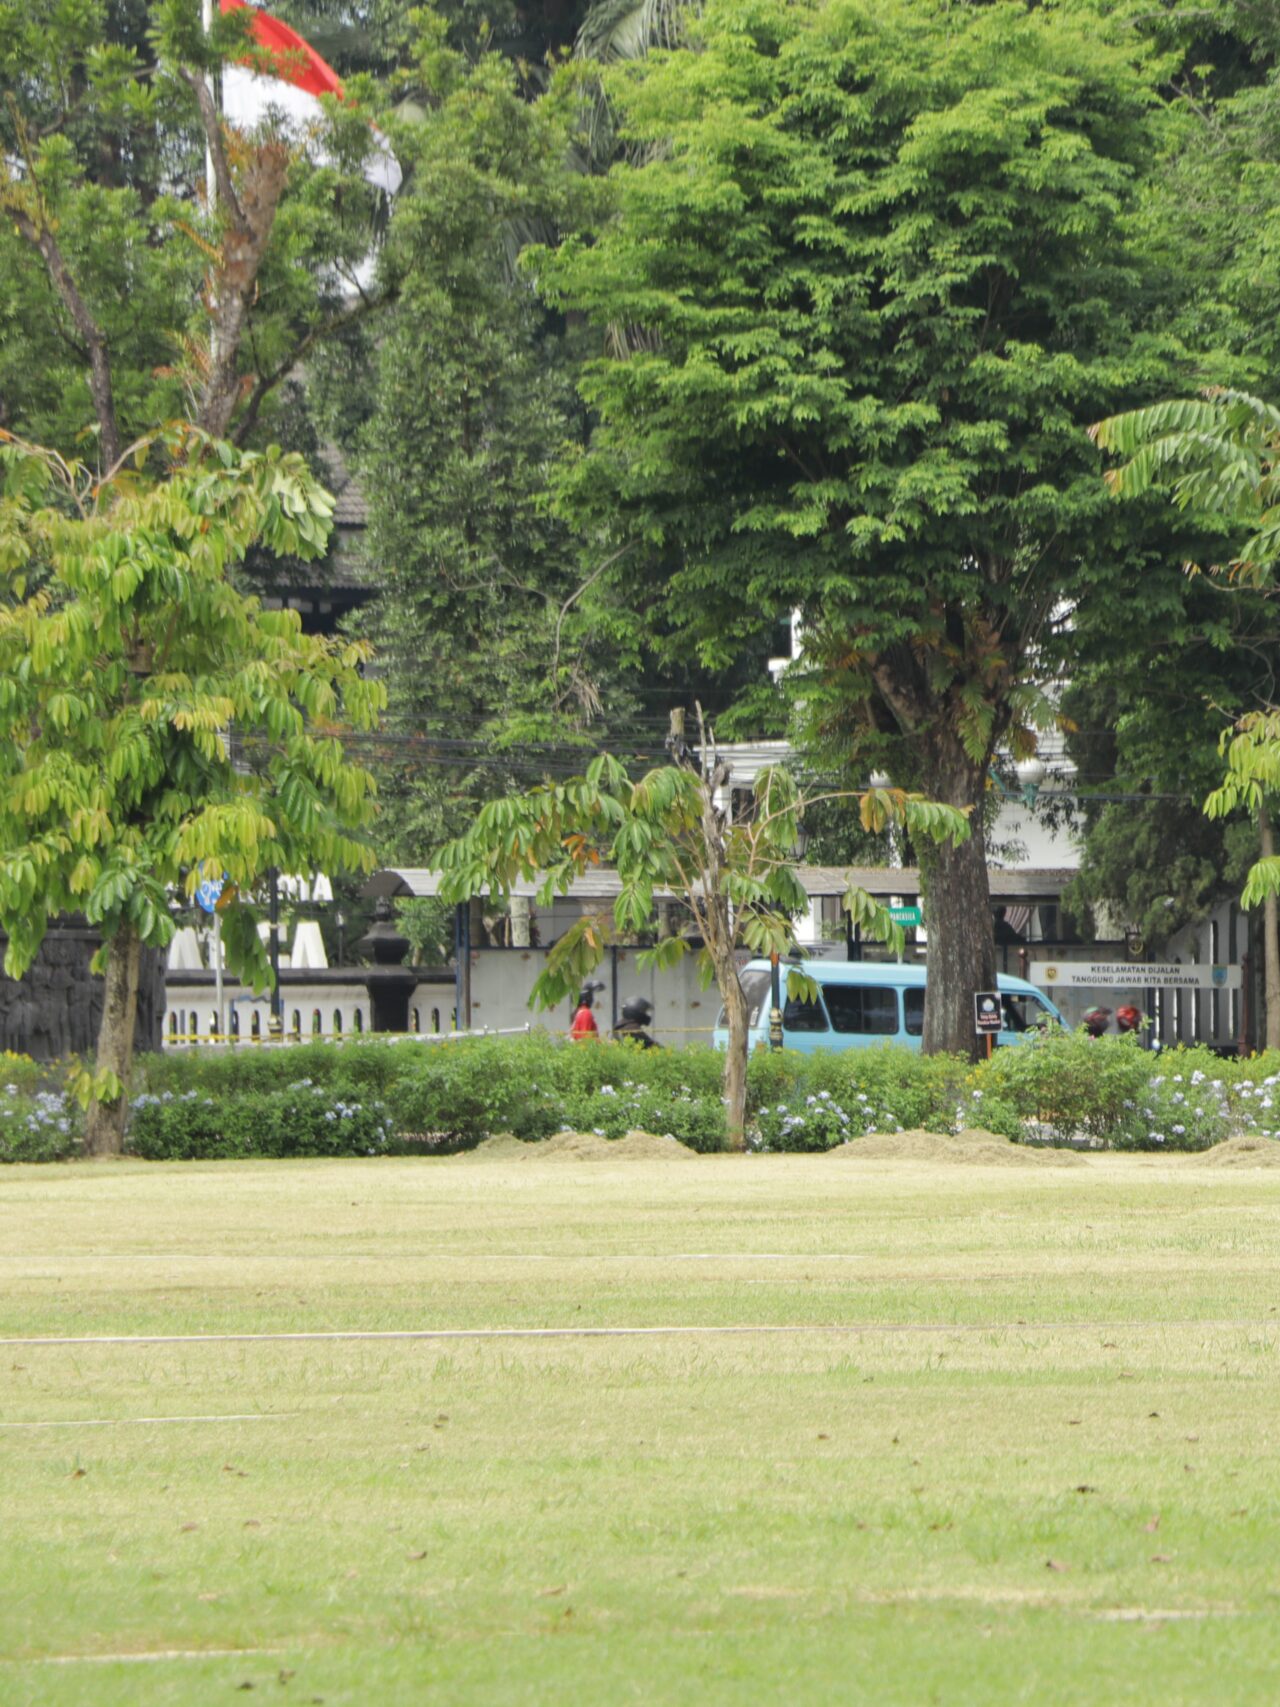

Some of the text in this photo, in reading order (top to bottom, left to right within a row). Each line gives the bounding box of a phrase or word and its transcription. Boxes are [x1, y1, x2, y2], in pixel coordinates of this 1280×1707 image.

[1090, 965, 1180, 975] KESELAMATAN DIJALAN
[1072, 975, 1200, 985] TANGGUNG JAWAB KITA BERSAMA
